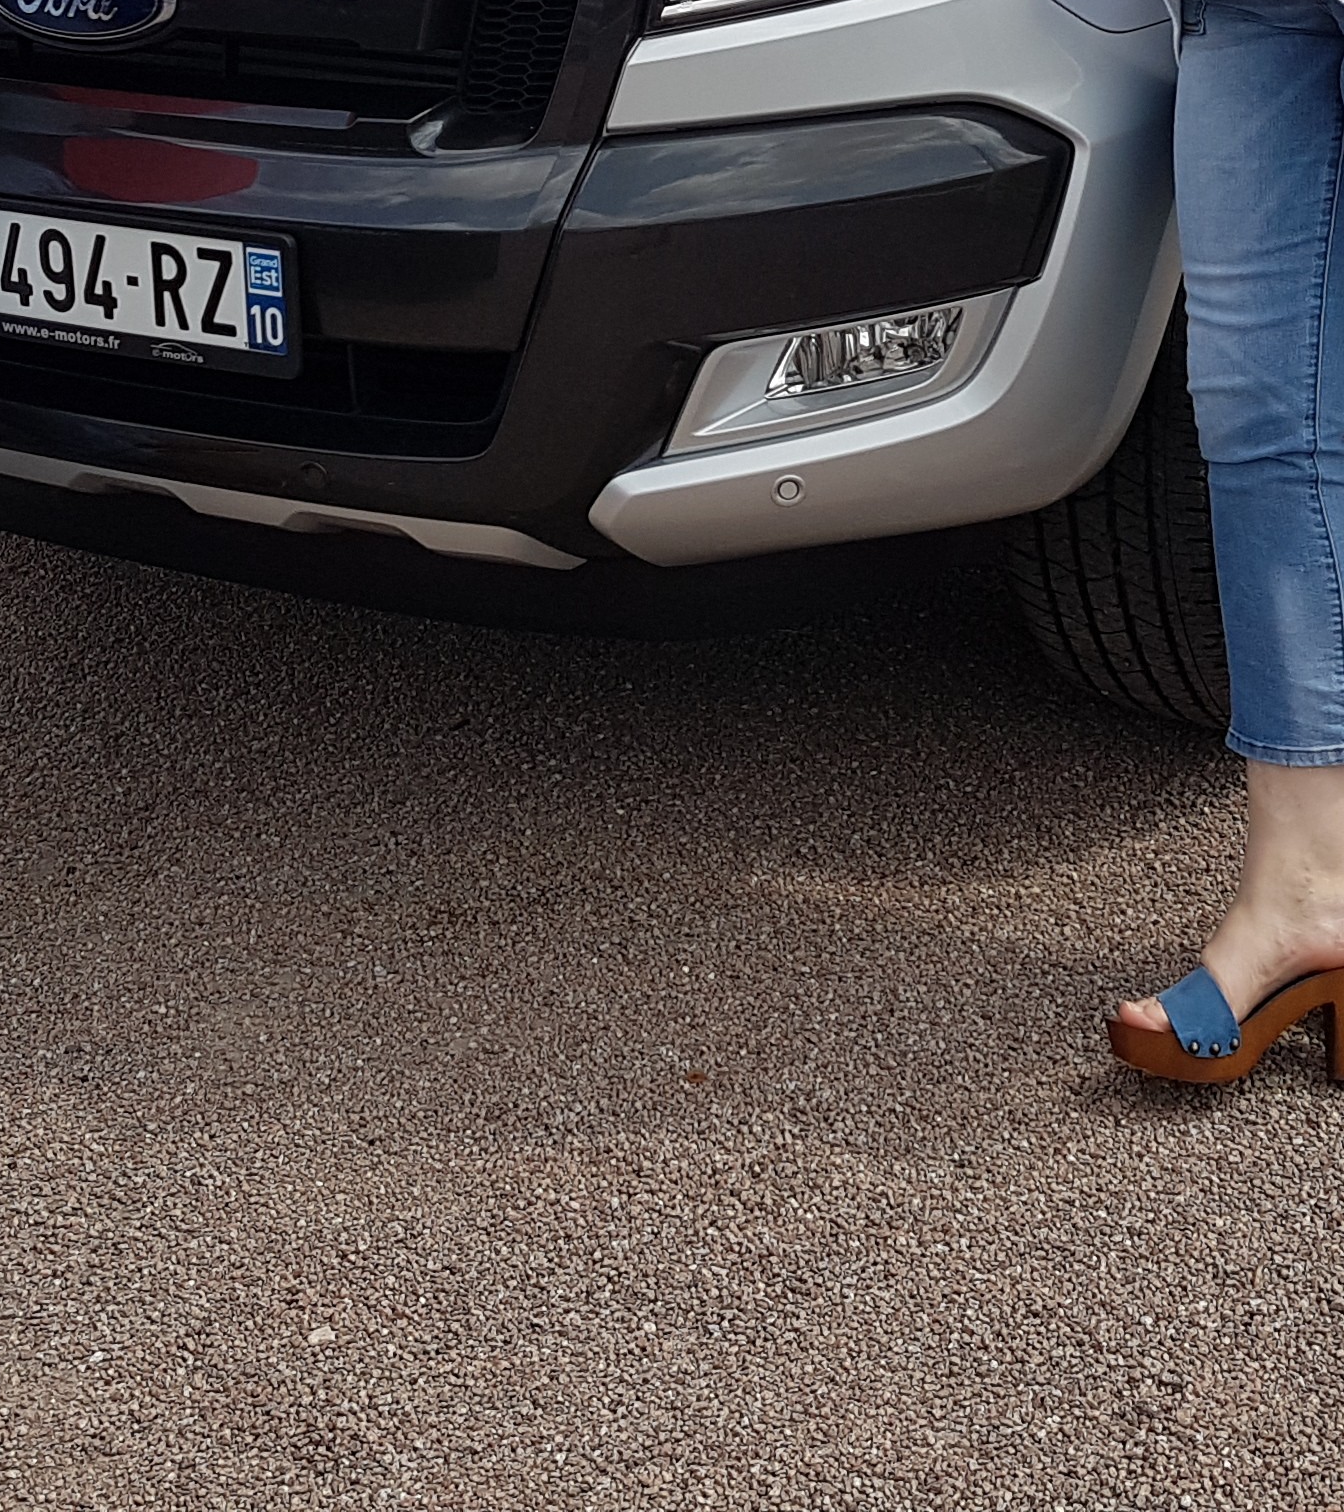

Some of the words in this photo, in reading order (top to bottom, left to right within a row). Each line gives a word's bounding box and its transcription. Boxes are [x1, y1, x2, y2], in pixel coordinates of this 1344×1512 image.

[249, 256, 278, 268] Grand
[251, 266, 278, 286] Est
[2, 322, 121, 349] www.e-motors.fr
[250, 305, 284, 346] 10
